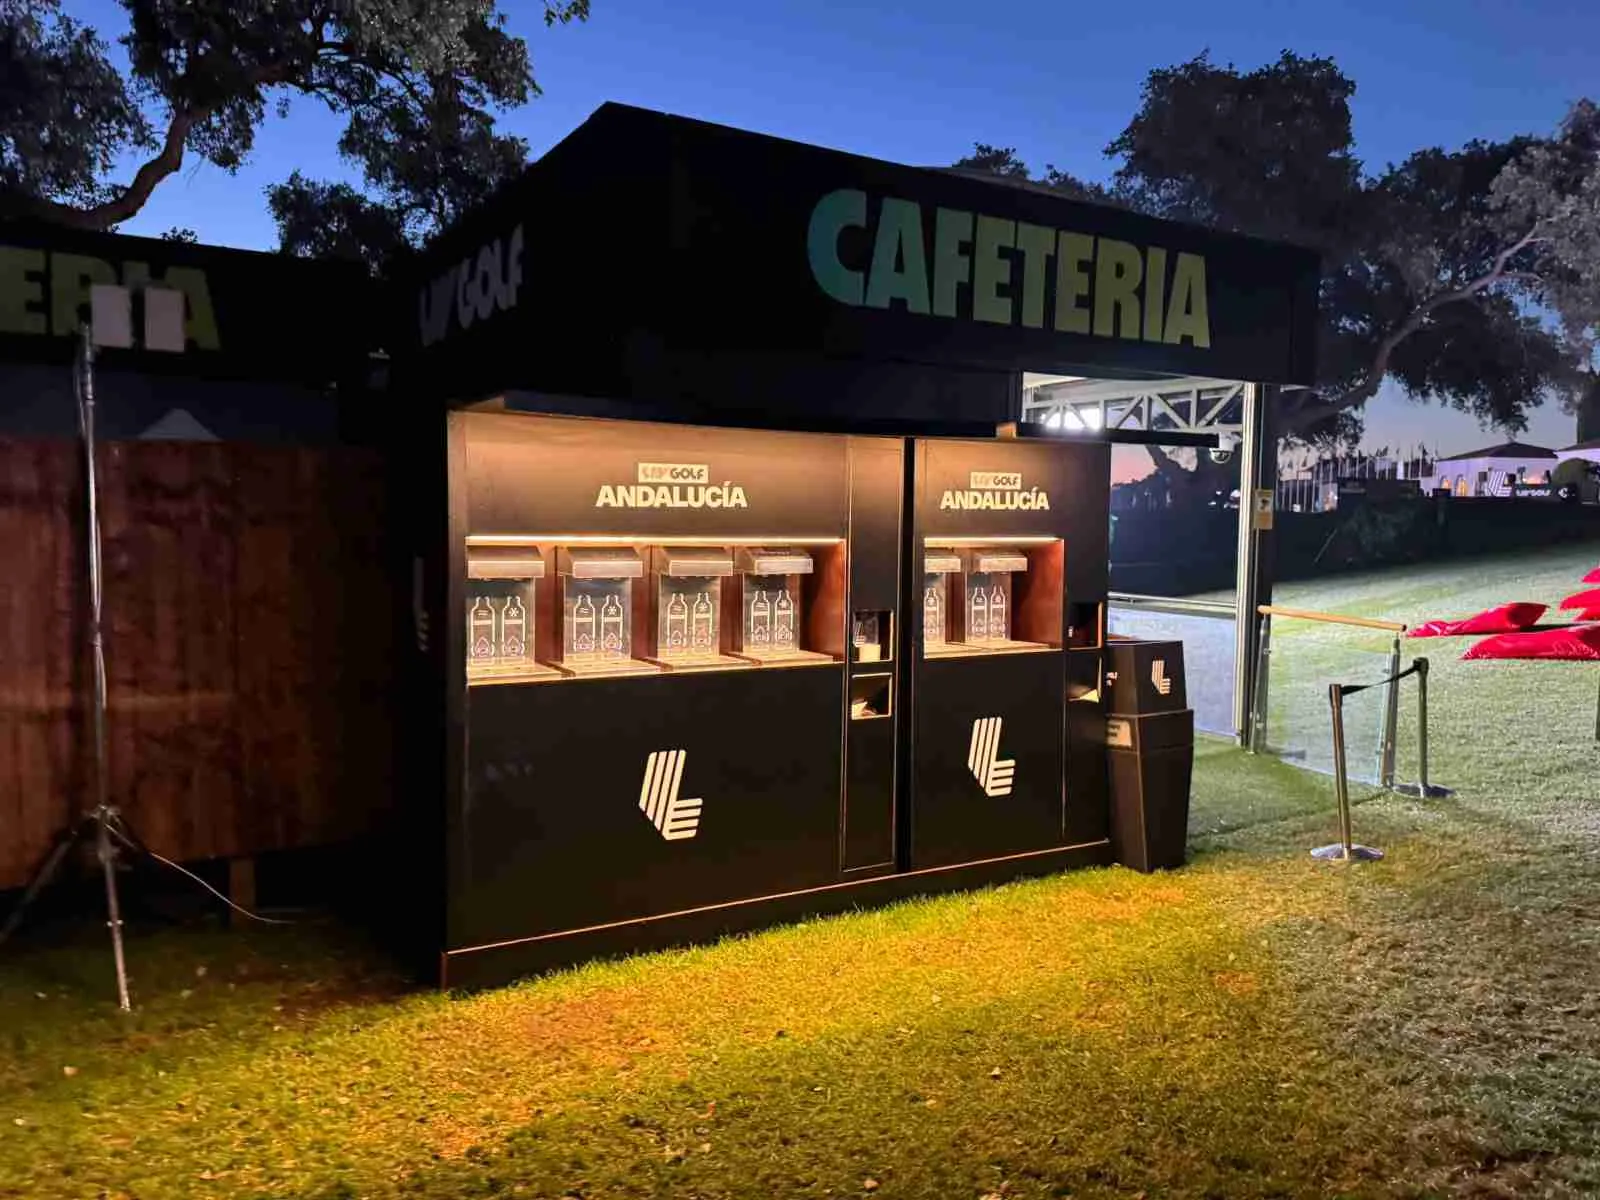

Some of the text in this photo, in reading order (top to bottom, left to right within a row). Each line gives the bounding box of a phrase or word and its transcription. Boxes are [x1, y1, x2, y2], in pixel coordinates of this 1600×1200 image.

[457, 221, 524, 331] GOLF
[806, 188, 1211, 349] CAFETERIA
[670, 467, 705, 480] GOLF
[595, 480, 748, 508] ANDALUCÍA
[940, 486, 1050, 510] ANDALUCÍA
